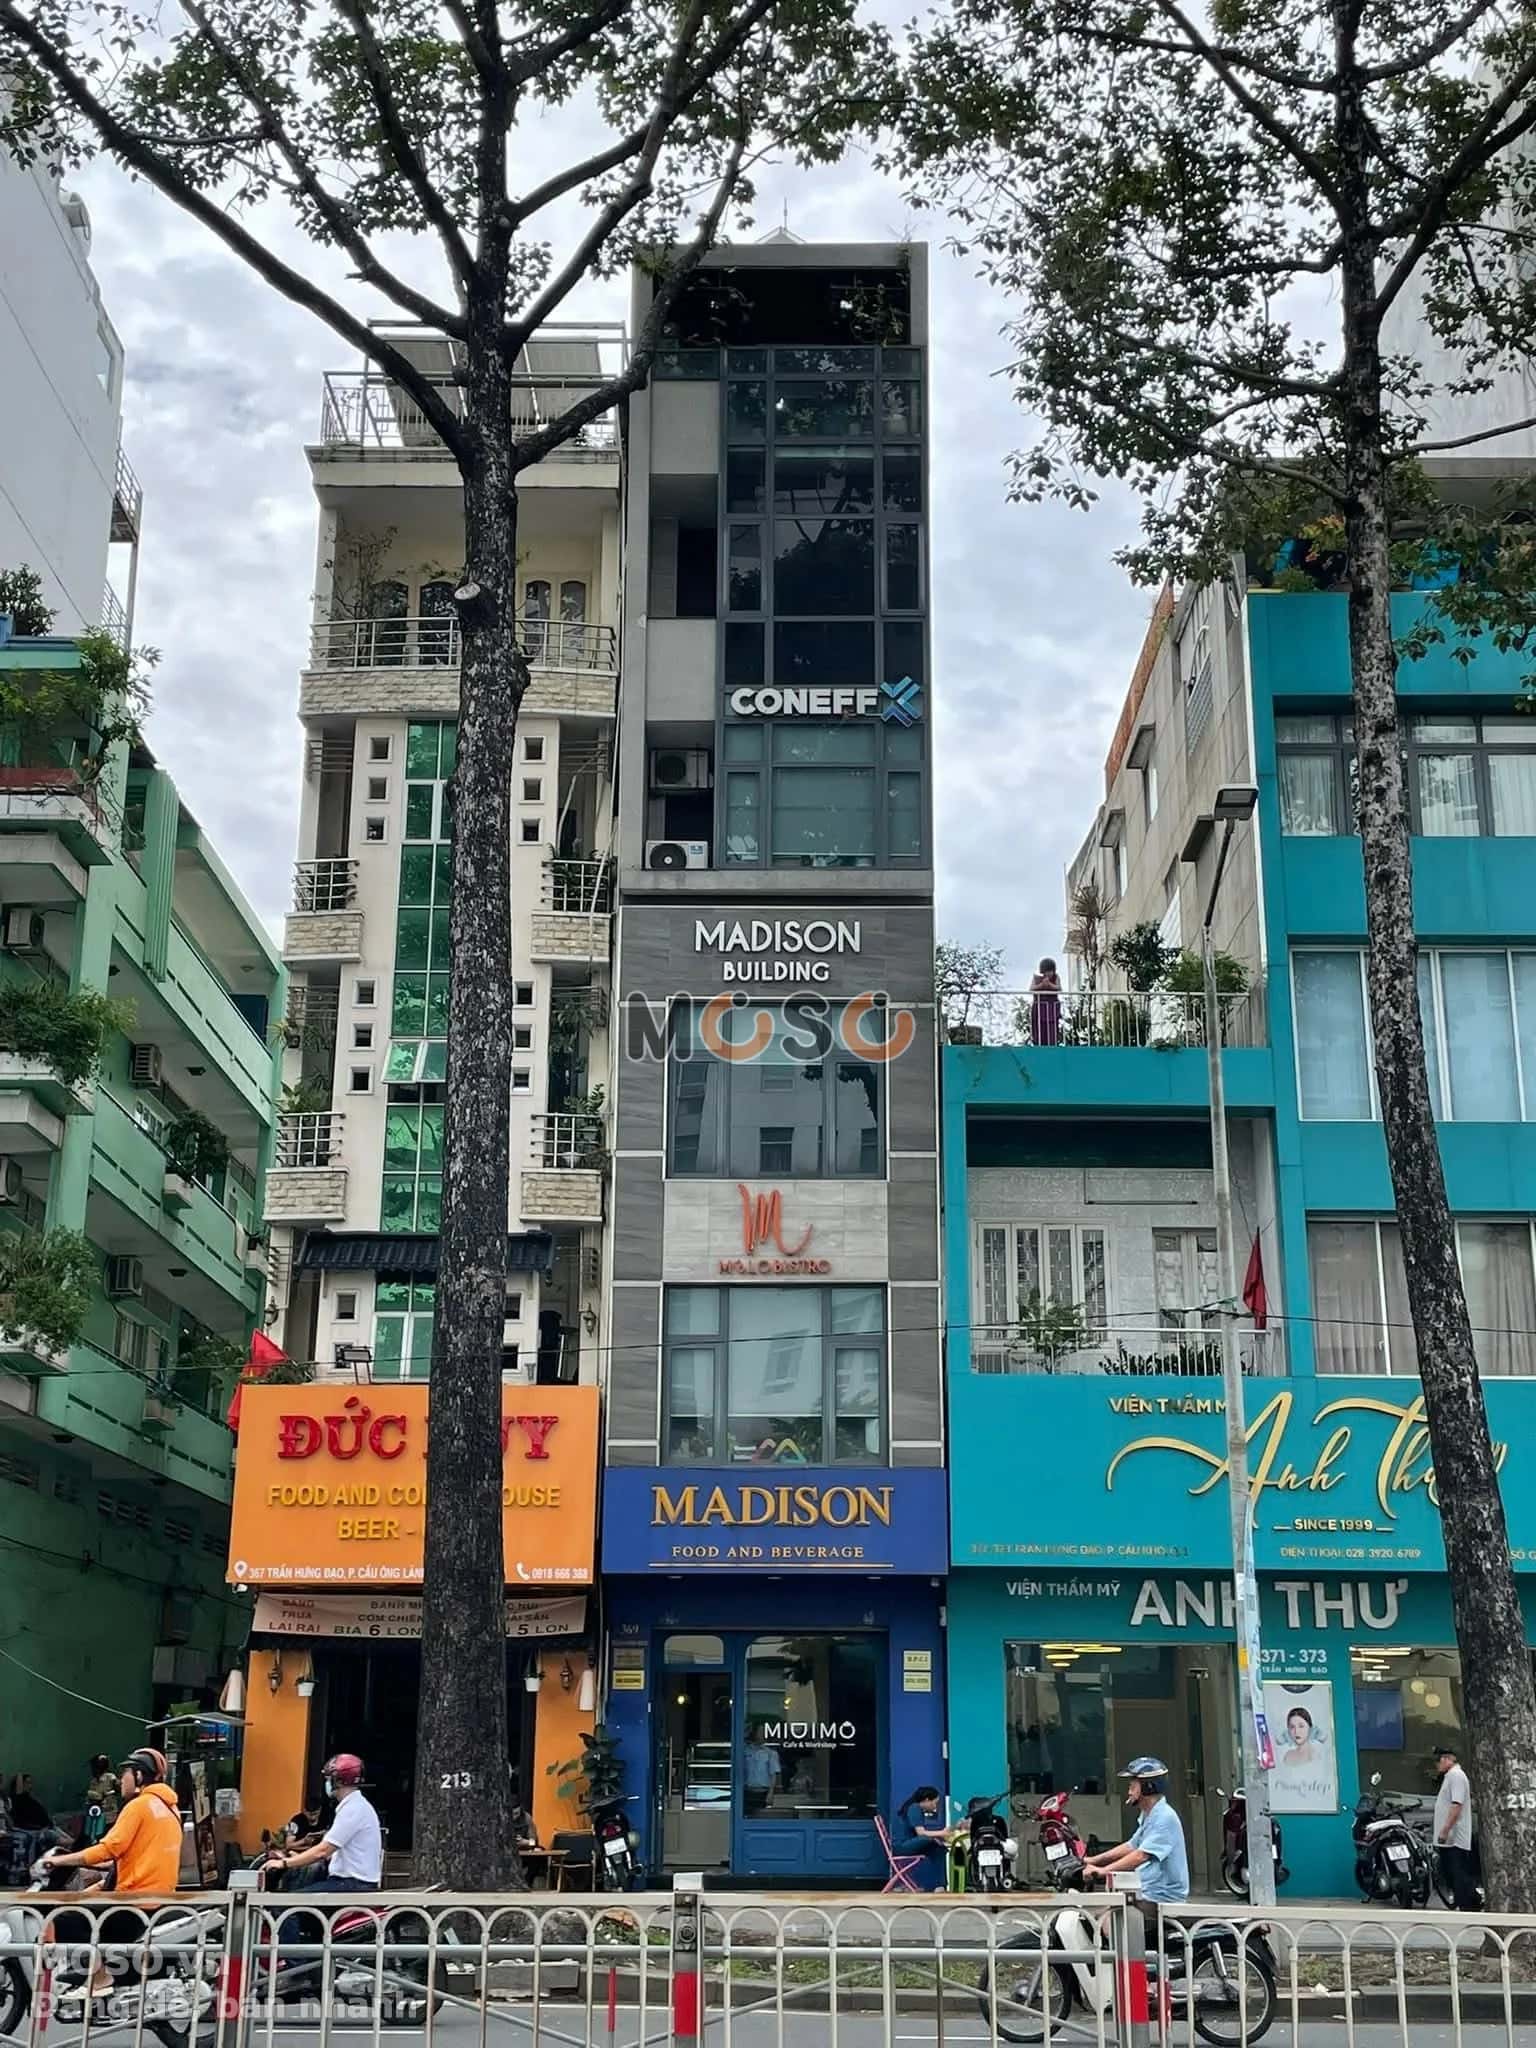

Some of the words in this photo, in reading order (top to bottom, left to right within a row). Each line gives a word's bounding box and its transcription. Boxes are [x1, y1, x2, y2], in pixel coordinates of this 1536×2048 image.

[694, 919, 861, 953] MADISON
[722, 961, 831, 982] BUILDING
[1110, 1392, 1153, 1416] VIỆN
[277, 1396, 407, 1460] ĐỨC
[268, 1484, 329, 1508] FOOD
[333, 1484, 381, 1508] AND
[651, 1485, 894, 1527] MADISON
[338, 1517, 400, 1541] BEER
[1294, 1518, 1337, 1531] SINCE
[1340, 1519, 1373, 1532] 1999
[672, 1546, 719, 1558] FOOD
[727, 1546, 763, 1558] AND
[771, 1546, 864, 1559] BEVERAGE
[1345, 1548, 1365, 1559] 028
[1006, 1578, 1042, 1599] VIỆN
[1096, 1578, 1120, 1597] MỸ
[1273, 1579, 1408, 1630] THƯ
[269, 1621, 292, 1631] LAI
[296, 1623, 321, 1633] RAI
[333, 1625, 361, 1635] BIA
[369, 1624, 380, 1637] 6
[386, 1626, 421, 1636] LON
[517, 1623, 529, 1636] 5
[535, 1623, 569, 1634] LON
[1261, 1648, 1286, 1664] 371
[1298, 1648, 1327, 1664] 373
[440, 1771, 472, 1789] 213
[1506, 1793, 1536, 1809] 215
